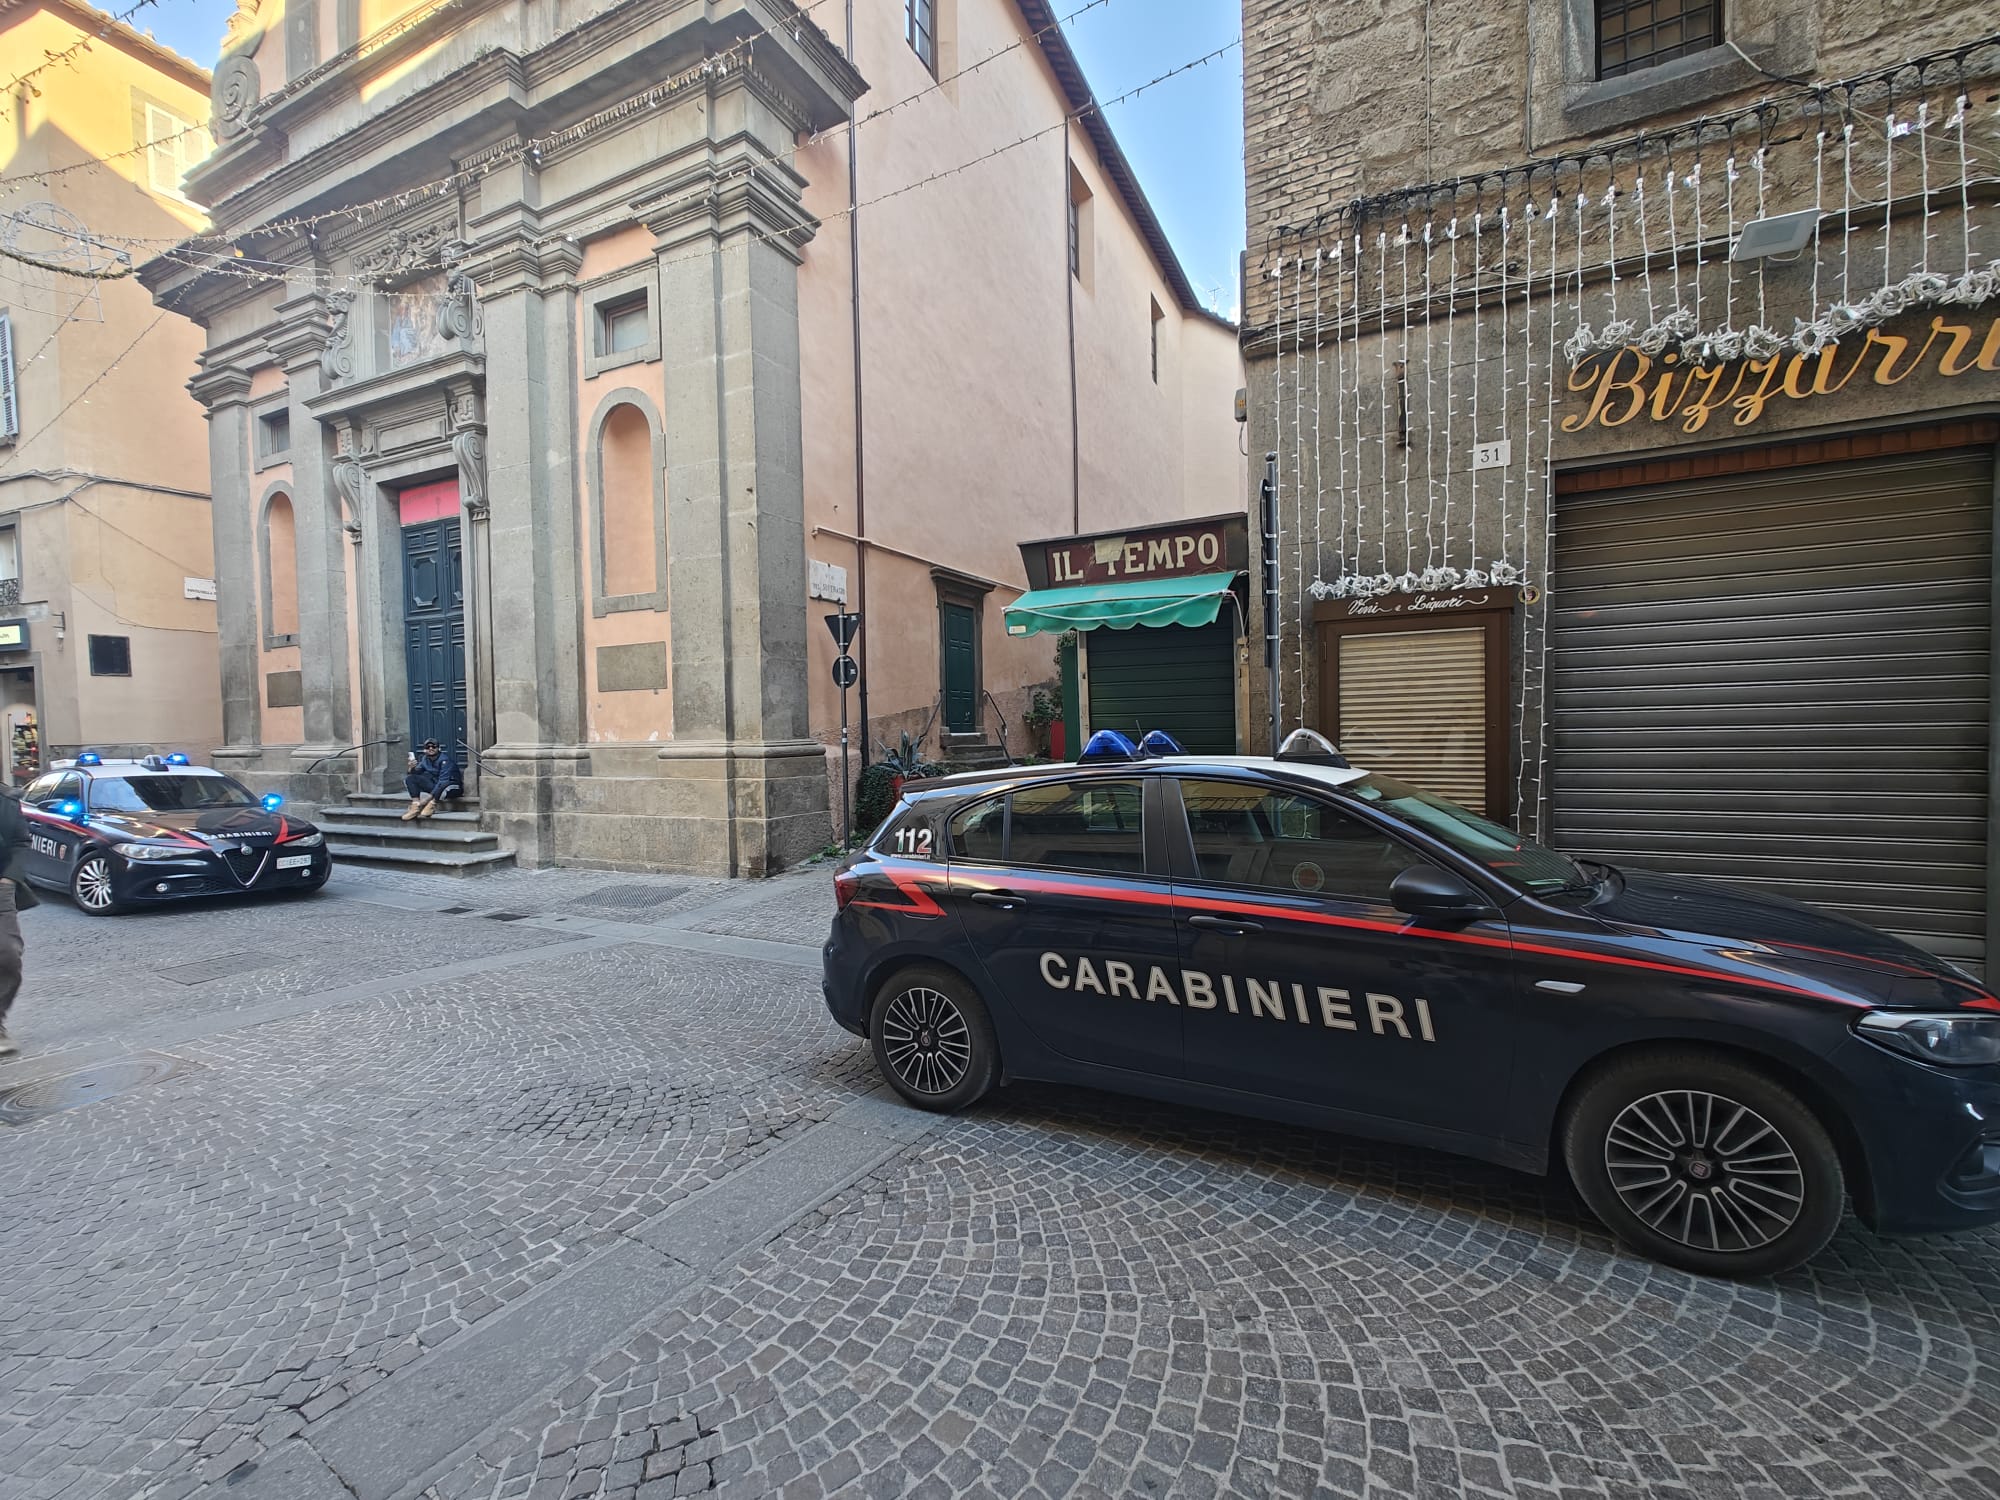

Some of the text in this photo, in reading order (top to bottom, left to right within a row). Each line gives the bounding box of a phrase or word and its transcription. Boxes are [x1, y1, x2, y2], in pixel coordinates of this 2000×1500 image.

[1480, 447, 1499, 463] 31
[1052, 551, 1084, 581] IL
[1348, 597, 1392, 615] Vini
[1408, 594, 1488, 612] Liquori
[29, 833, 58, 857] NIERI
[202, 831, 272, 841] CARABINIERI
[894, 827, 932, 854] 112
[1039, 951, 1436, 1042] CARABINIERI
